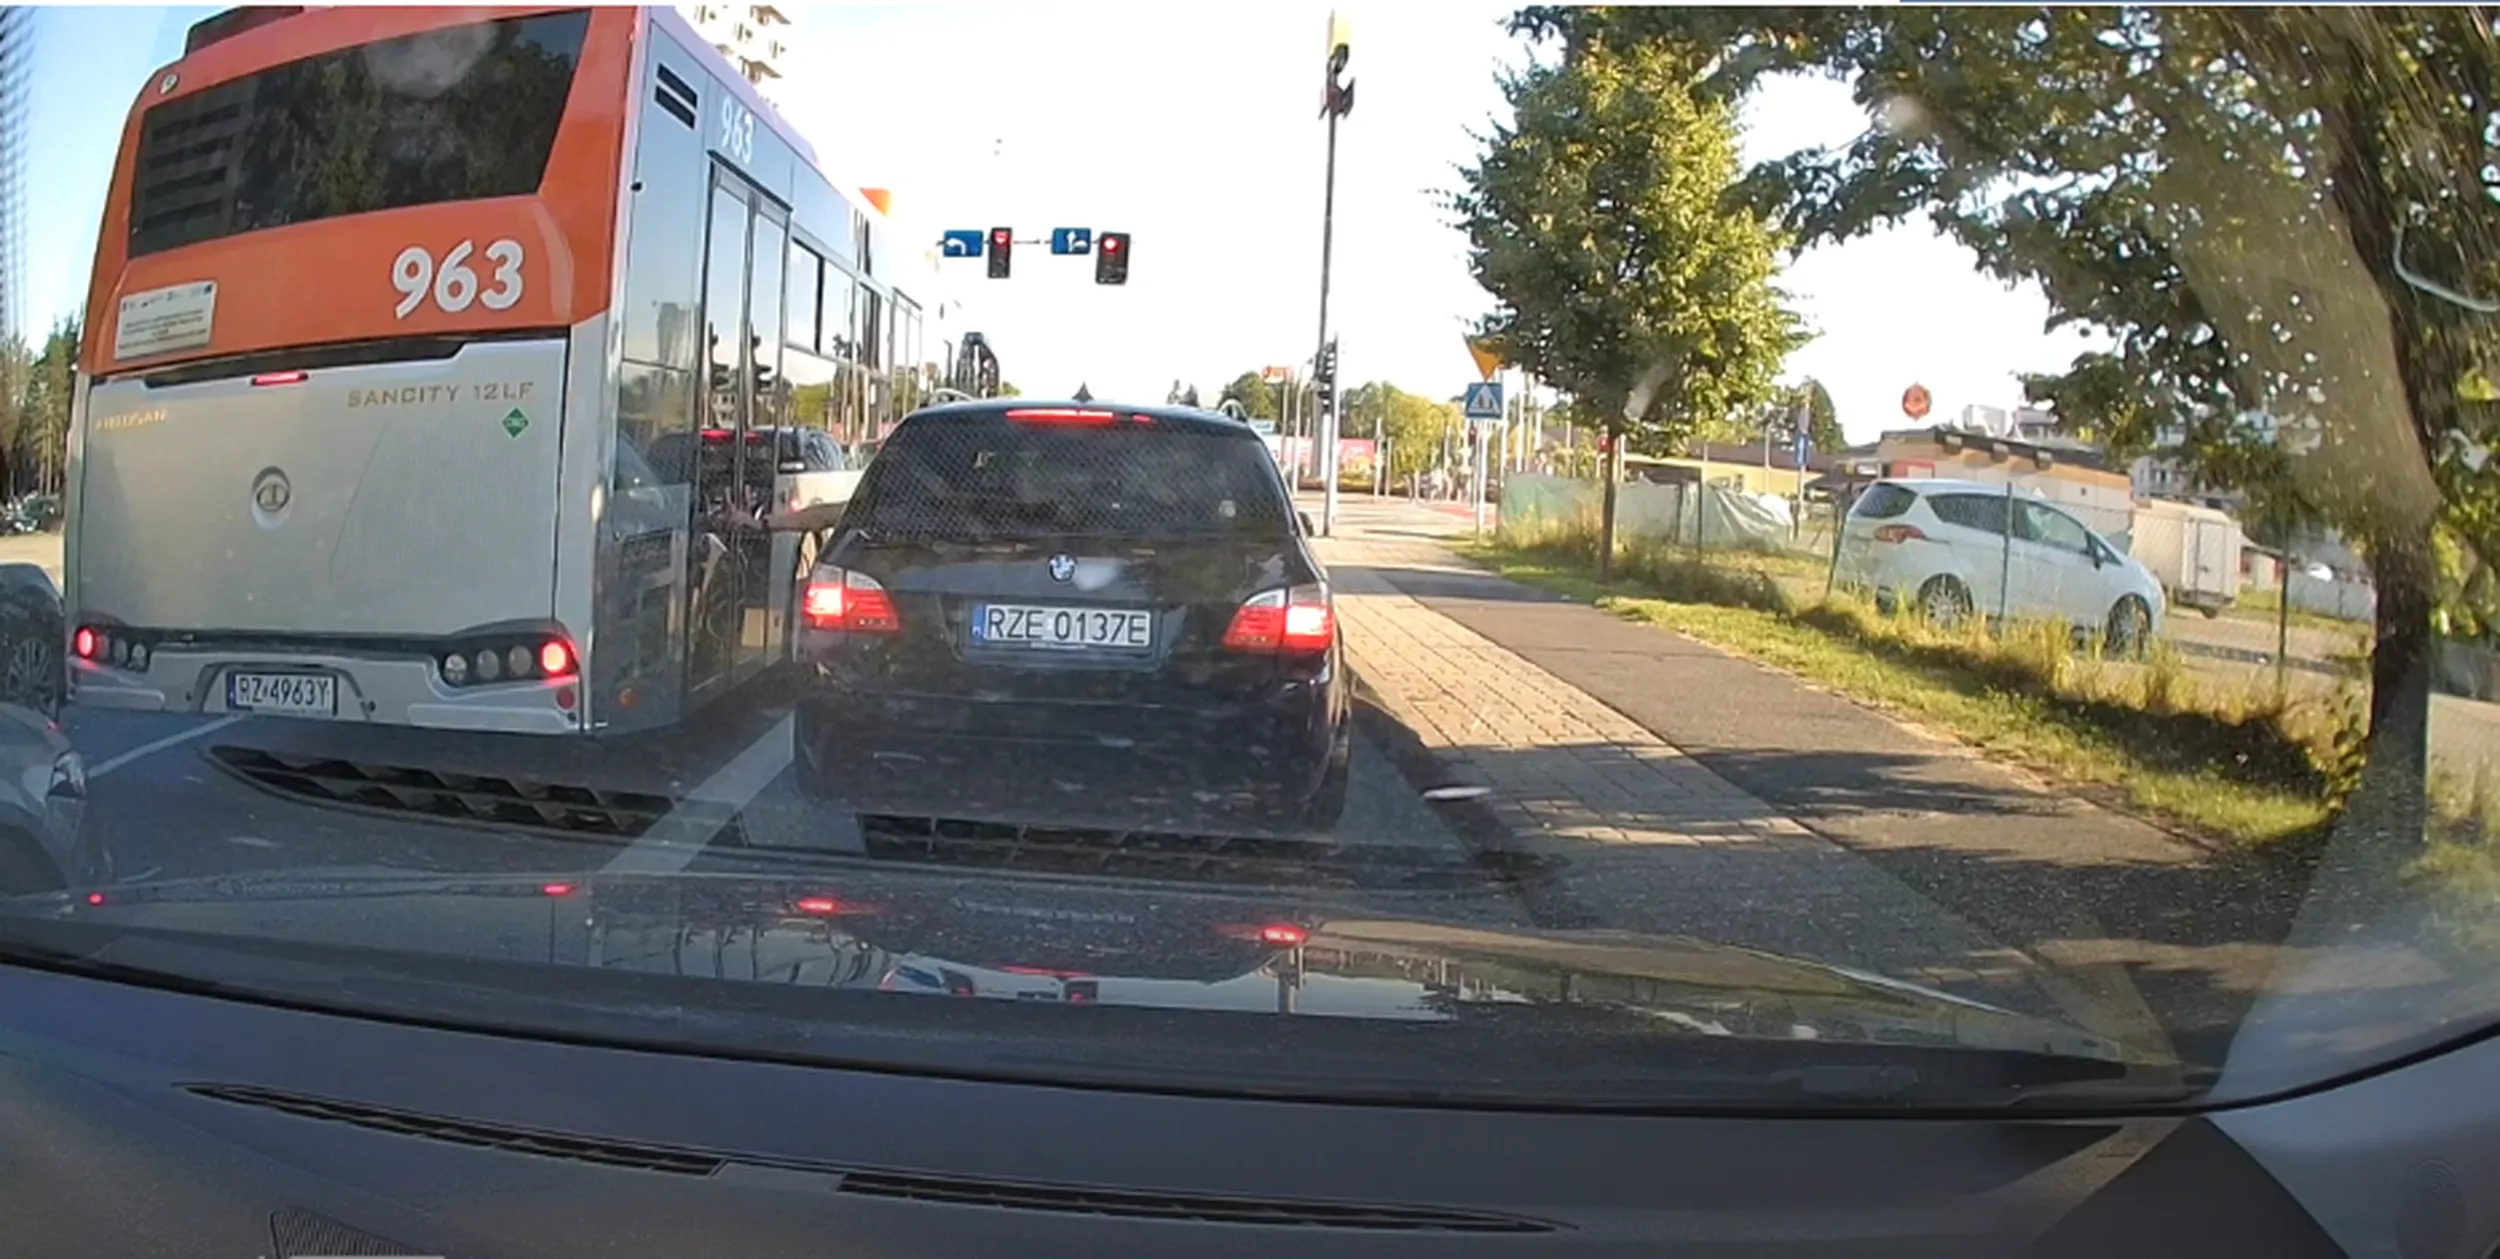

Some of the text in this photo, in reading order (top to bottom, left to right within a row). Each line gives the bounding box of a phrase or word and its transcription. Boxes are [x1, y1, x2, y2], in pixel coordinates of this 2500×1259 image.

[722, 95, 753, 165] 963
[392, 239, 523, 319] 963
[347, 381, 534, 408] SANCITY 12LF
[988, 608, 1147, 645] RZE 0137E
[239, 676, 330, 708] RZ 4963Y
